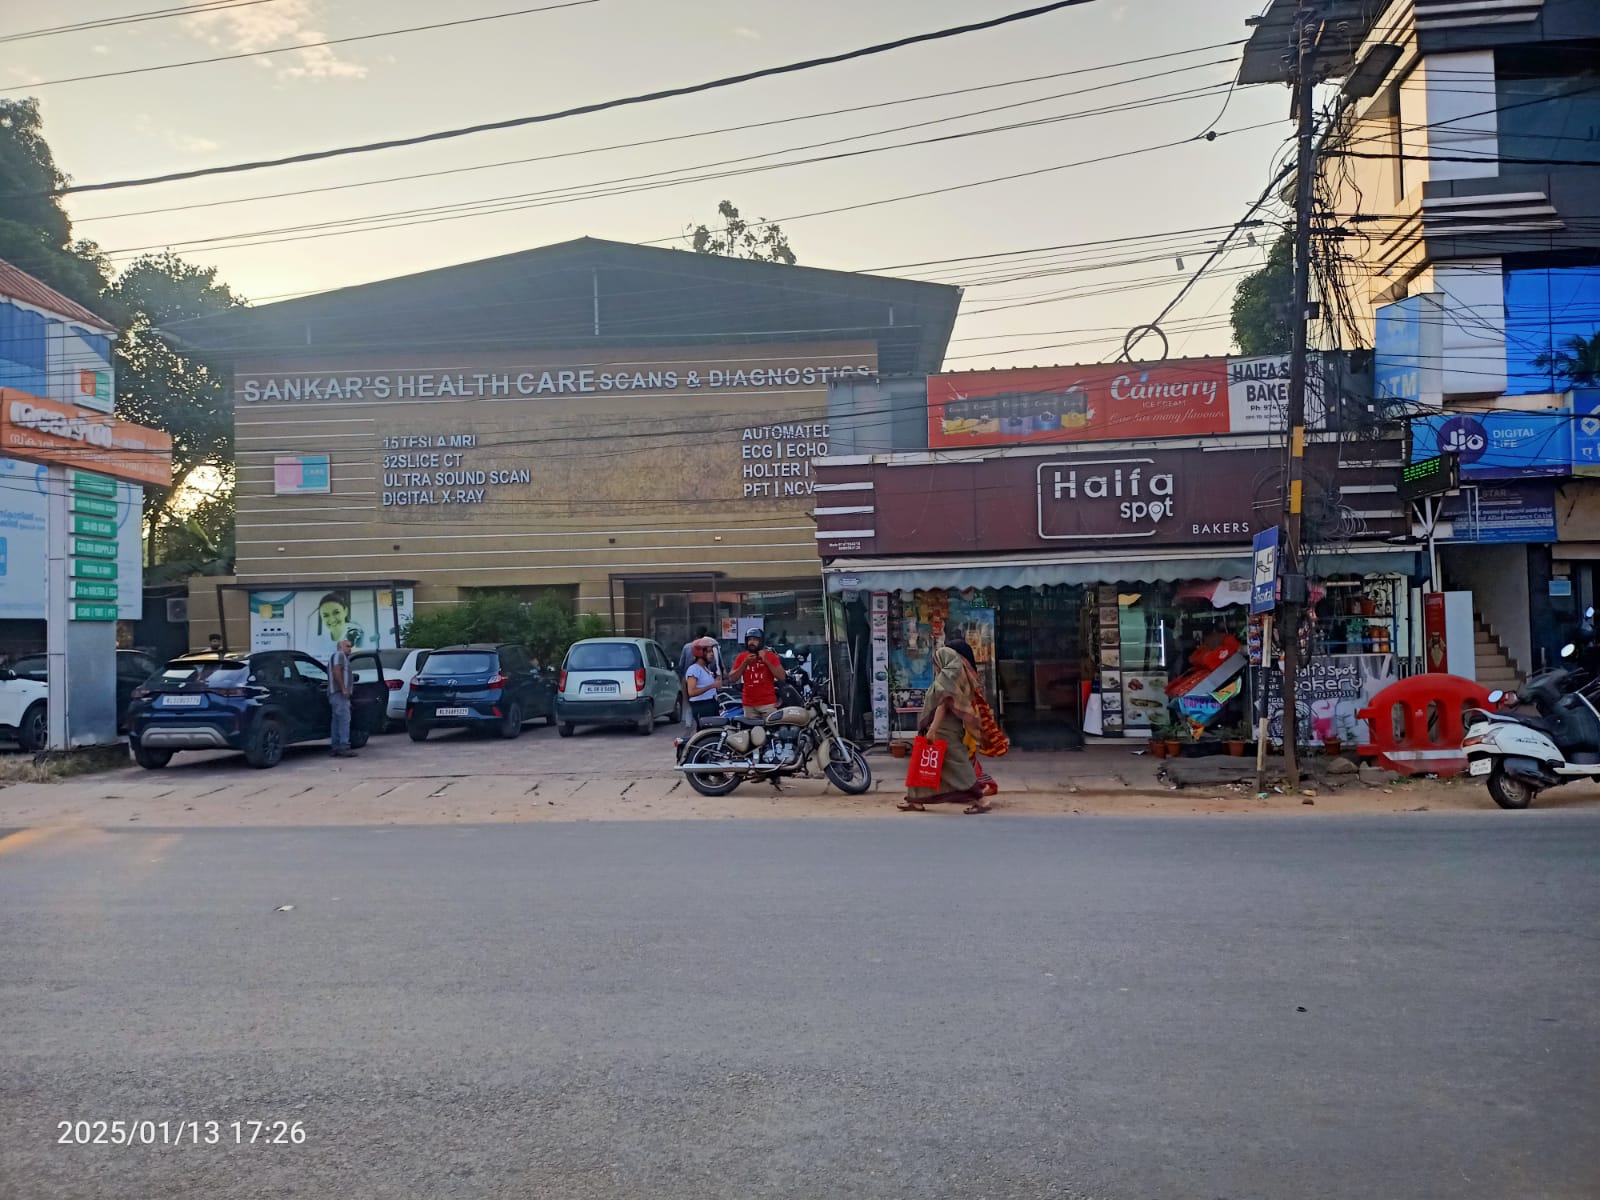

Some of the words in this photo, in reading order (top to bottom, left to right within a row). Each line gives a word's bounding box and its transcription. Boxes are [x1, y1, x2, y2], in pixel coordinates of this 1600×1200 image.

[243, 376, 390, 402] SANKAR'S
[397, 372, 510, 398] HEALTH
[516, 369, 595, 395] CARE
[599, 370, 678, 390] SCANS
[686, 370, 702, 388] &
[1246, 382, 1289, 402] BAKE
[1377, 371, 1417, 398] ATM
[450, 434, 476, 447] MRI
[1493, 428, 1535, 438] DIGITAL
[443, 453, 464, 467] CT
[742, 444, 774, 460] ECG
[786, 442, 829, 458] ECHO
[383, 473, 433, 487] ULTRA
[435, 470, 486, 486] SOUND
[489, 468, 531, 484] SCAN
[743, 462, 801, 478] HOLTER
[743, 482, 771, 497] PFT
[784, 481, 814, 496] NCV
[1054, 467, 1174, 499] Haifa
[383, 490, 439, 506] DIGITAL
[441, 488, 486, 504] X-RAY
[1120, 496, 1174, 523] spot
[1192, 522, 1250, 535] BAKERS
[1327, 664, 1357, 679] Spot
